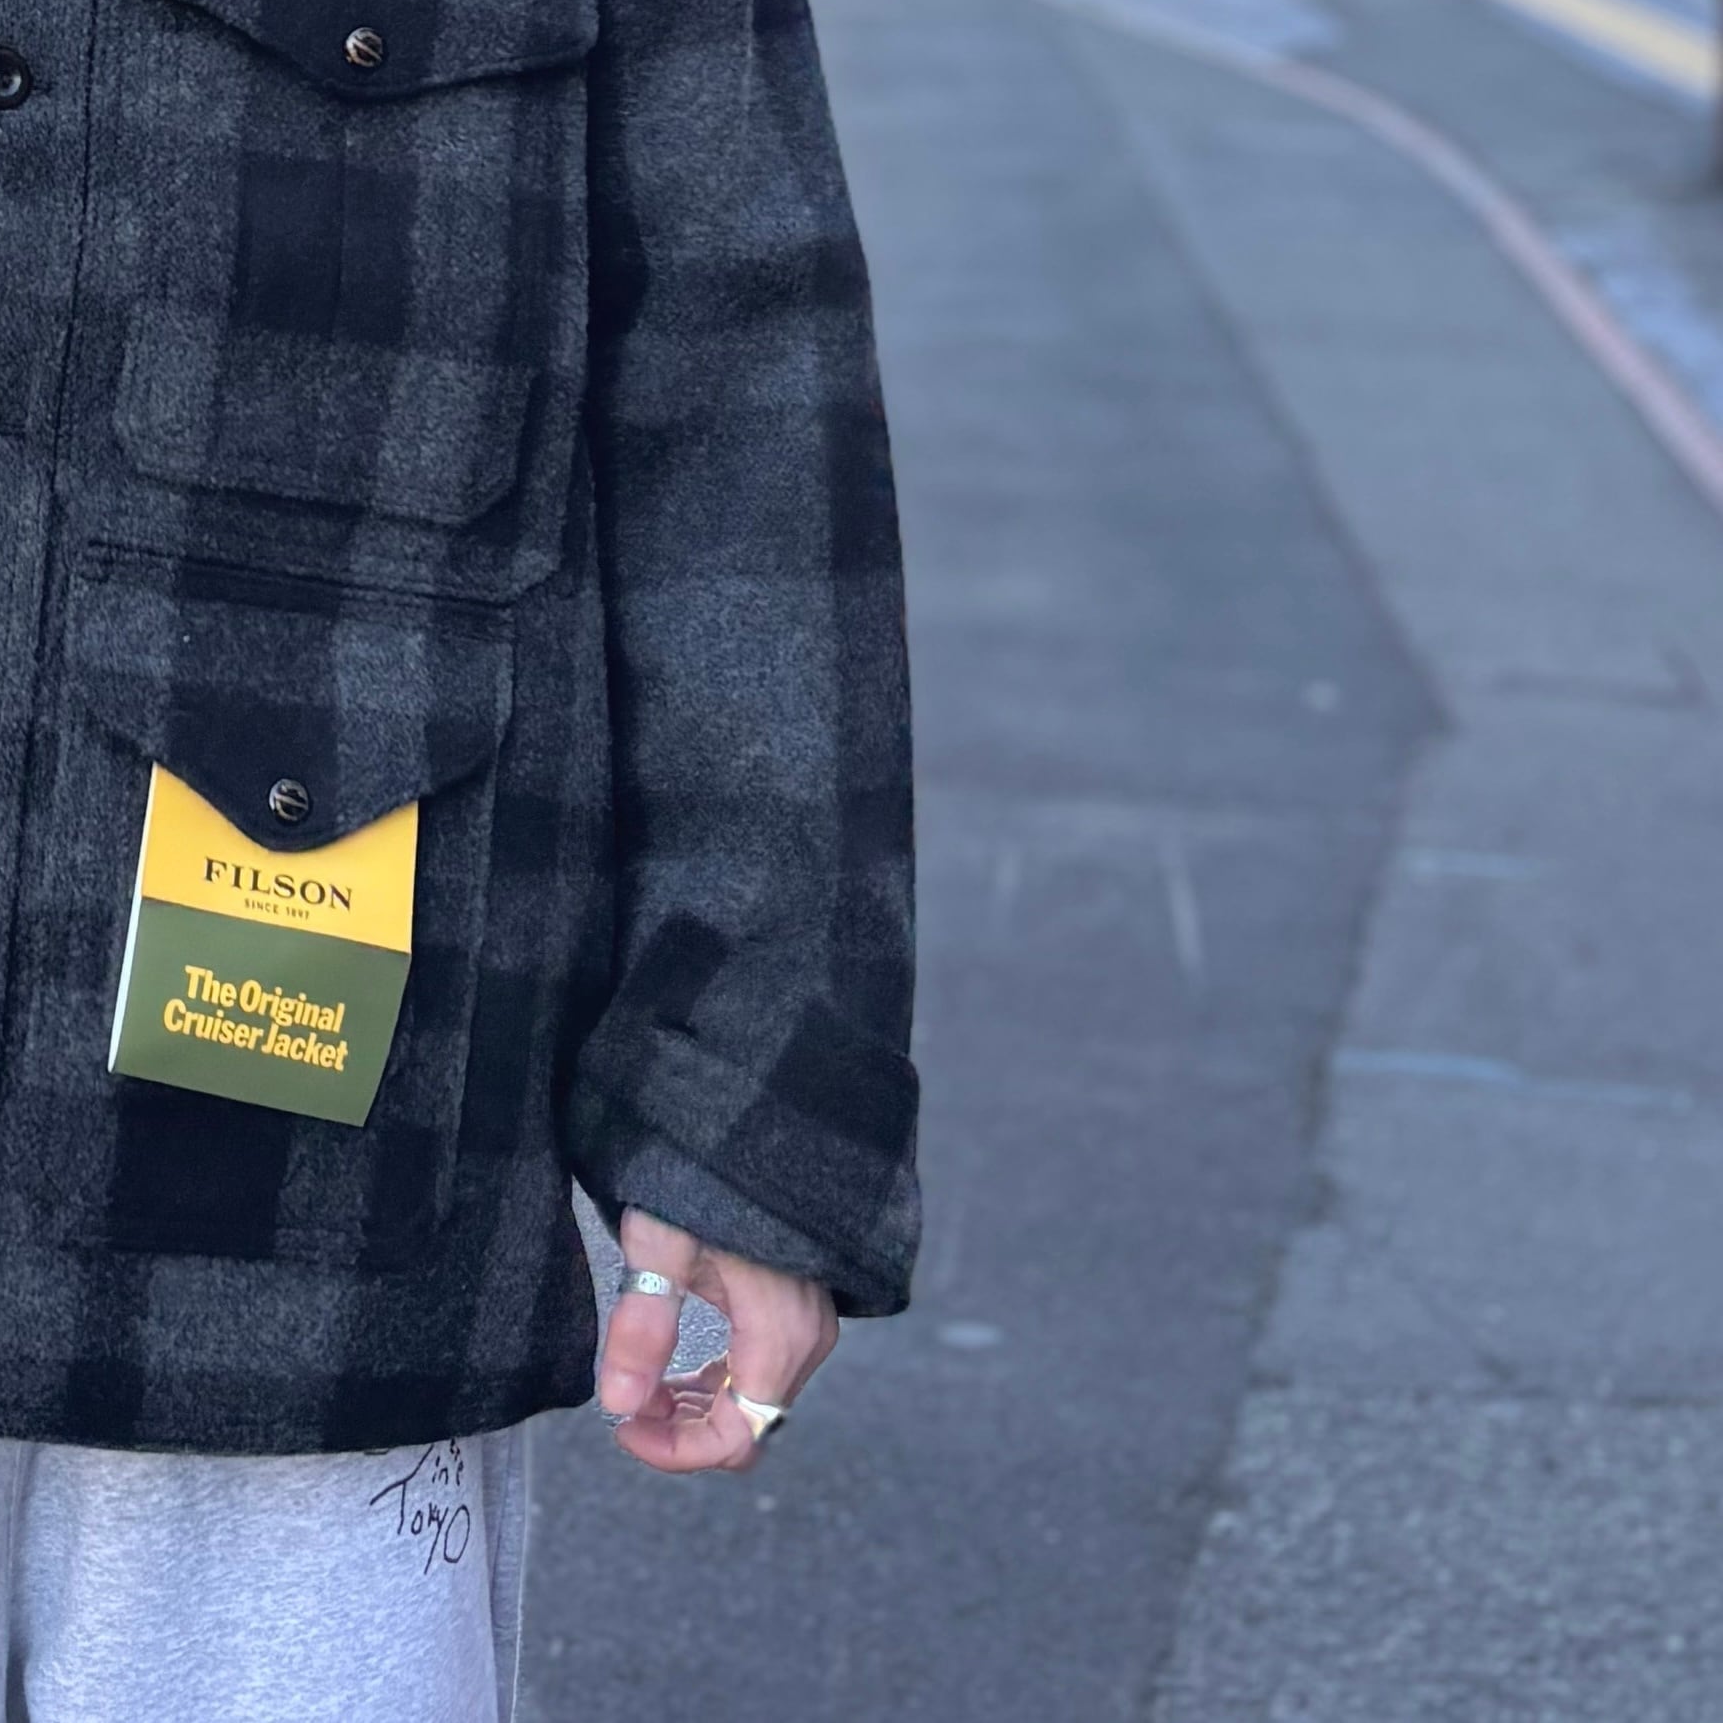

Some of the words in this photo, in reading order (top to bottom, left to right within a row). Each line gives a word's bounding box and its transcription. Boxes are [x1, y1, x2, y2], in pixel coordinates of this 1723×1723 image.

[204, 856, 353, 911] FILSON
[244, 898, 279, 915] SINCE
[185, 964, 237, 1008] The
[239, 979, 345, 1034] Original
[163, 998, 264, 1051] Cruiser
[261, 1022, 348, 1072] Jacket
